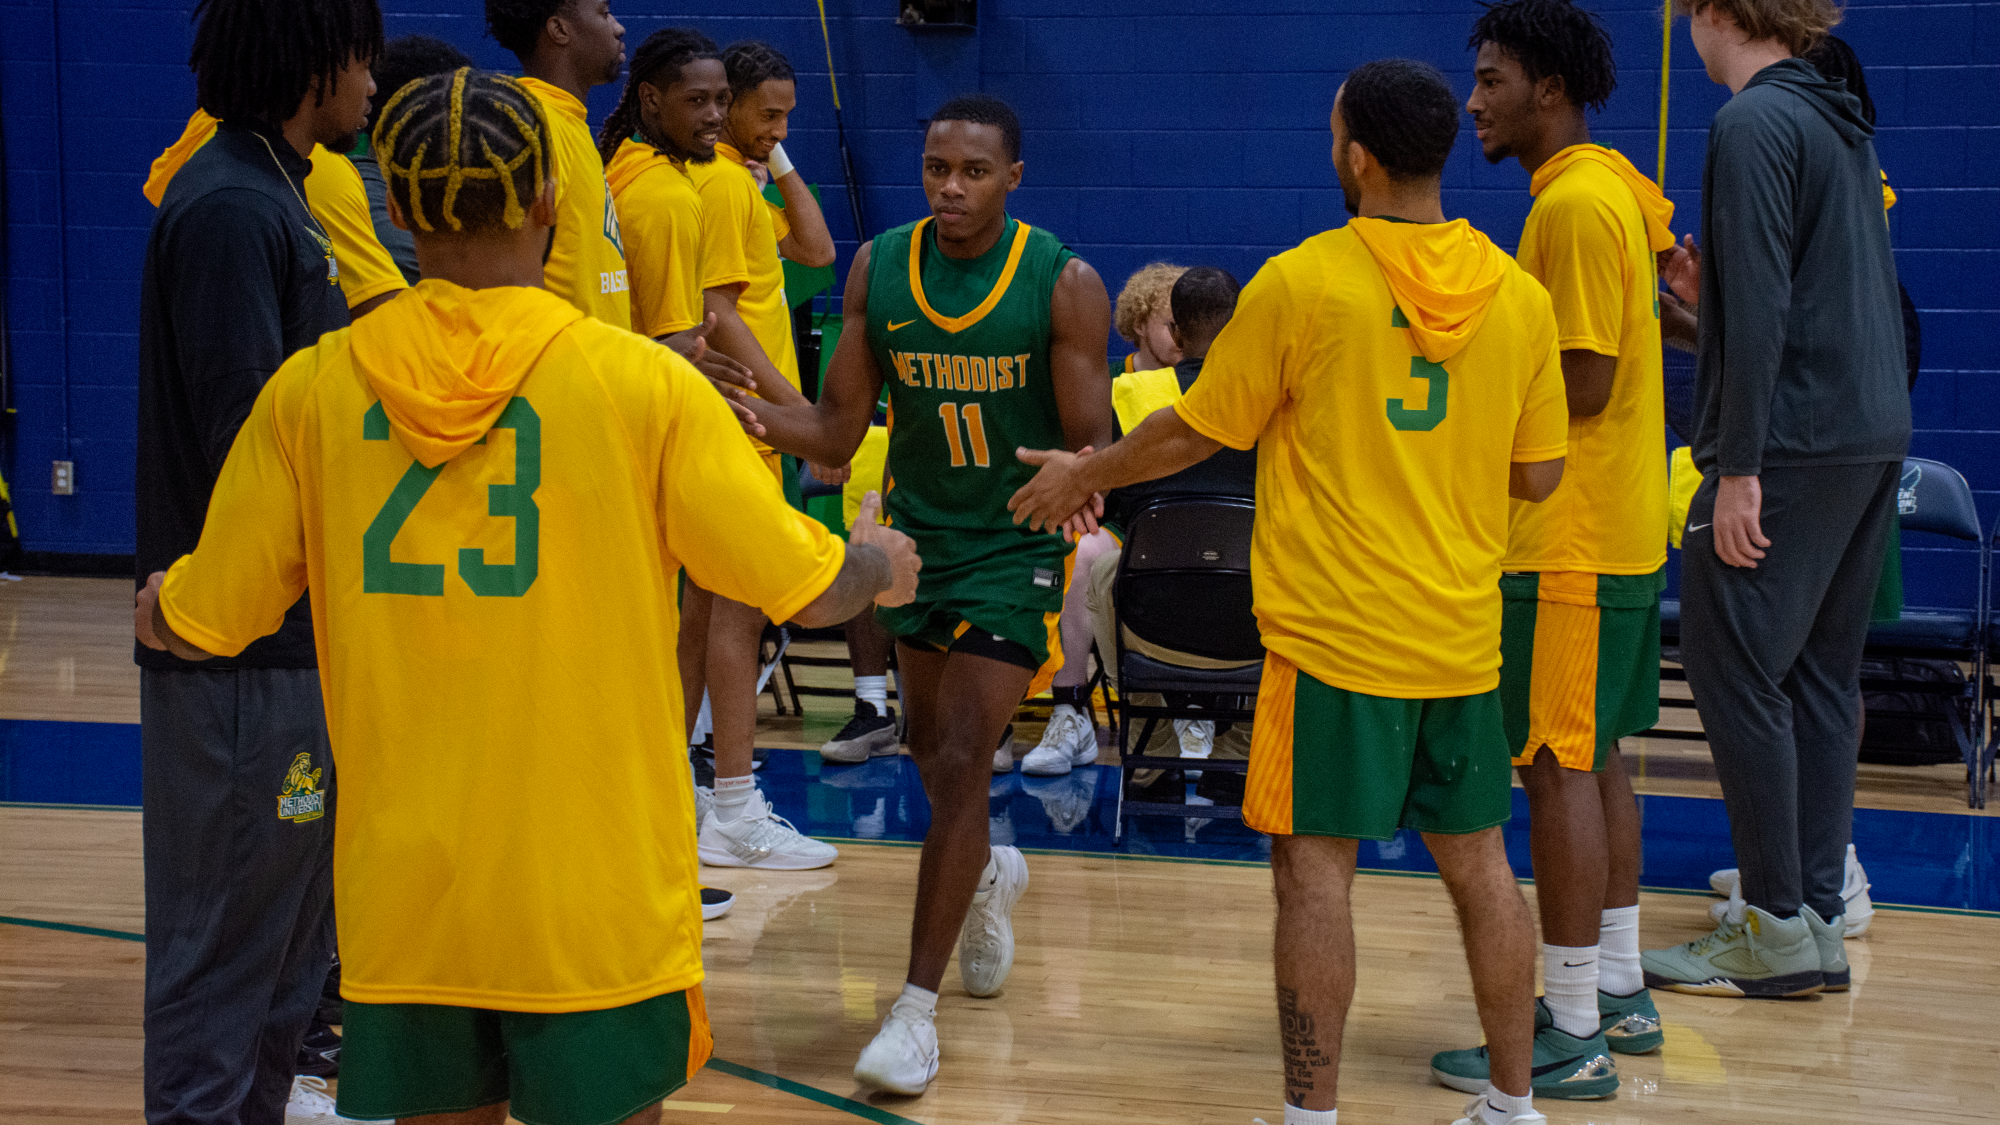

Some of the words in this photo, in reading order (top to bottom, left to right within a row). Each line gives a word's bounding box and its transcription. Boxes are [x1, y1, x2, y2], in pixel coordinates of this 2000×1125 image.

[889, 349, 1031, 393] METHODIST
[1386, 304, 1449, 431] 3
[938, 402, 991, 468] 11
[362, 396, 542, 597] 23
[280, 791, 324, 807] METHODIST
[280, 802, 323, 817] UNIVERSITY
[1306, 1048, 1322, 1057] for
[1310, 1056, 1330, 1068] will
[1298, 1068, 1313, 1079] for
